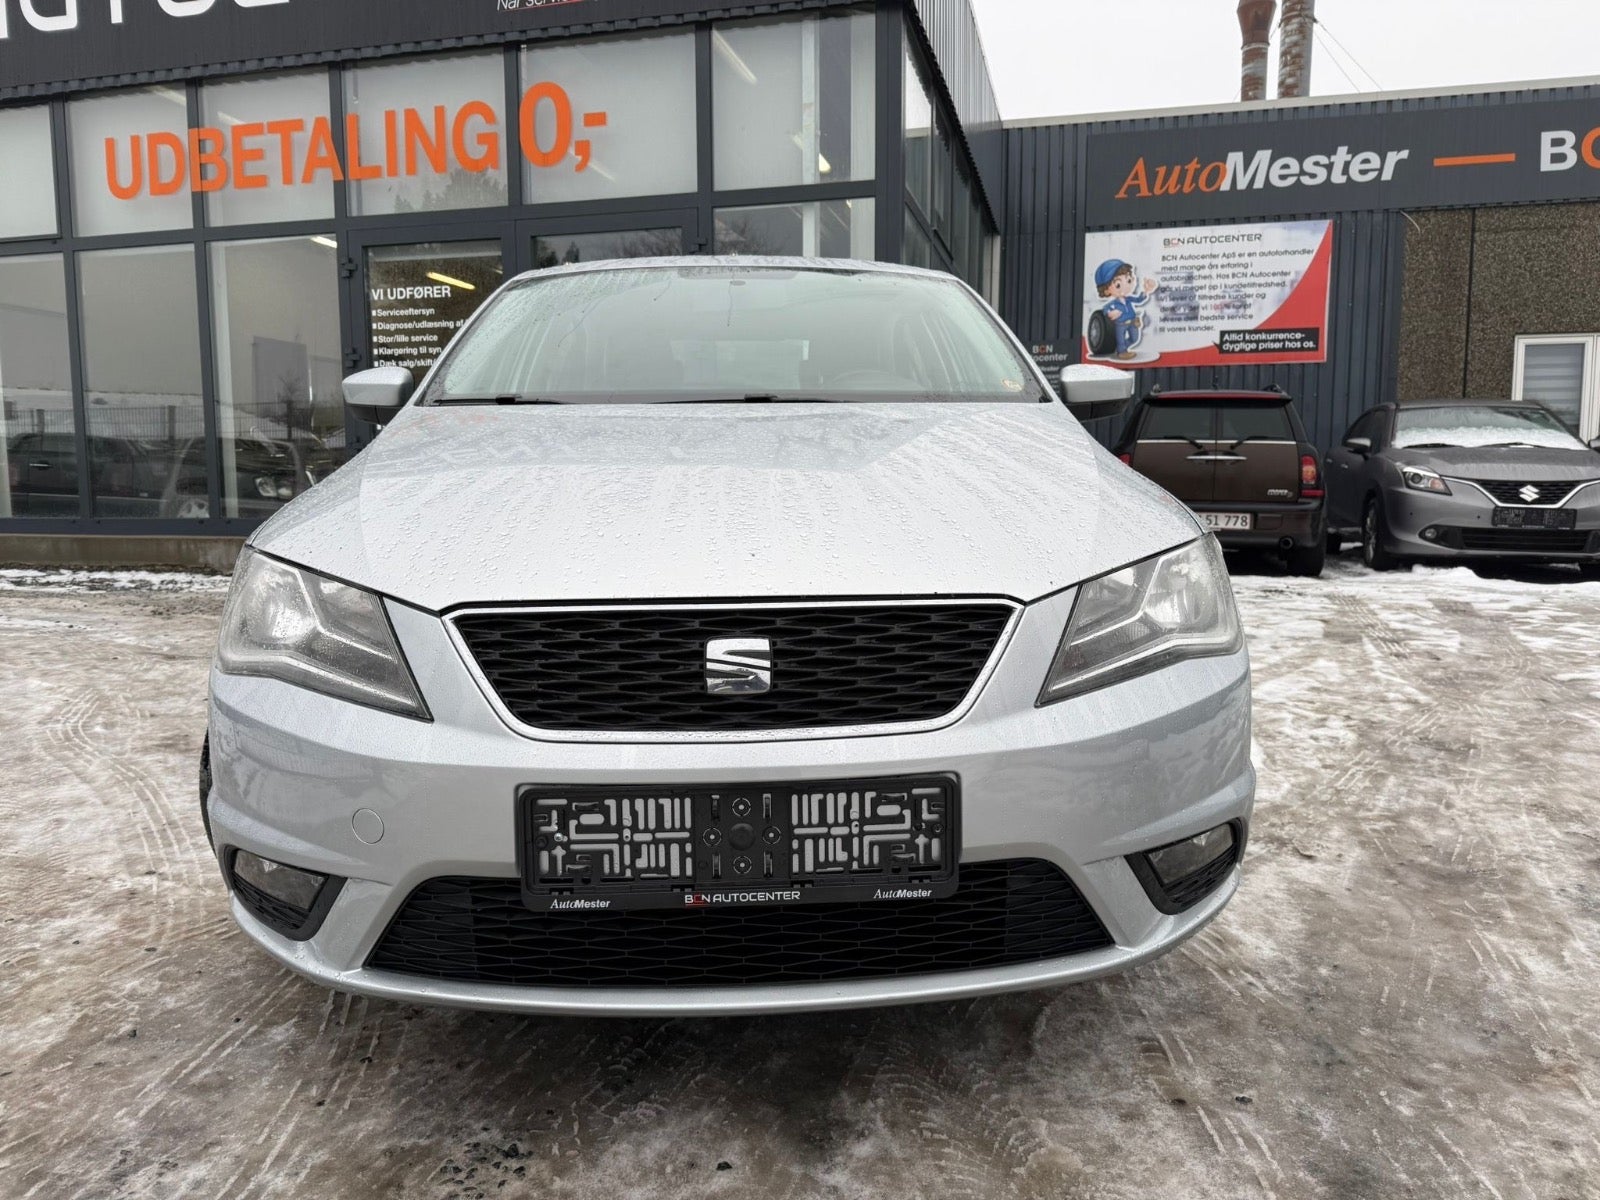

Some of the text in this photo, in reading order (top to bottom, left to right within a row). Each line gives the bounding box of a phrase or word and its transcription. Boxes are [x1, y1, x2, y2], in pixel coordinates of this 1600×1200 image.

[105, 81, 607, 200] UDBETALING 0,-
[1115, 145, 1409, 199] AutoMester
[1163, 233, 1263, 248] BCN AUTOCENTER
[1162, 254, 1178, 262] BCN
[1180, 252, 1220, 260] Autocenter
[1222, 251, 1237, 259] ApS
[1259, 248, 1314, 257] autoforhandler
[1161, 264, 1178, 272] med
[1180, 263, 1206, 272] mange
[1208, 262, 1218, 270] års
[1220, 261, 1249, 270] erfaring
[1217, 272, 1230, 280] Hos
[1232, 271, 1248, 279] BCN
[1250, 269, 1291, 278] Autocenter
[1208, 283, 1218, 291] op
[1224, 280, 1288, 289] kundetilfredshed.
[371, 285, 451, 300] VI UDFØRER
[1228, 292, 1253, 300] kunder
[1255, 292, 1266, 300] og
[377, 307, 435, 317] Serviceeftersyn
[377, 319, 454, 331] Diagnose/udlæsning
[1188, 324, 1216, 332] kunder.
[378, 333, 438, 343] Stor/lille service
[1223, 331, 1306, 342] Altid konkurrence-
[428, 346, 442, 355] syn
[1032, 344, 1054, 354] BCN
[1222, 340, 1316, 352] dygtige priser hos os.
[1031, 353, 1069, 362] ocenter
[1205, 514, 1248, 527] 51 778
[685, 891, 800, 906] BCN AUTOCENTER
[873, 888, 932, 899] AutoMester
[550, 898, 611, 909] AutoMester
